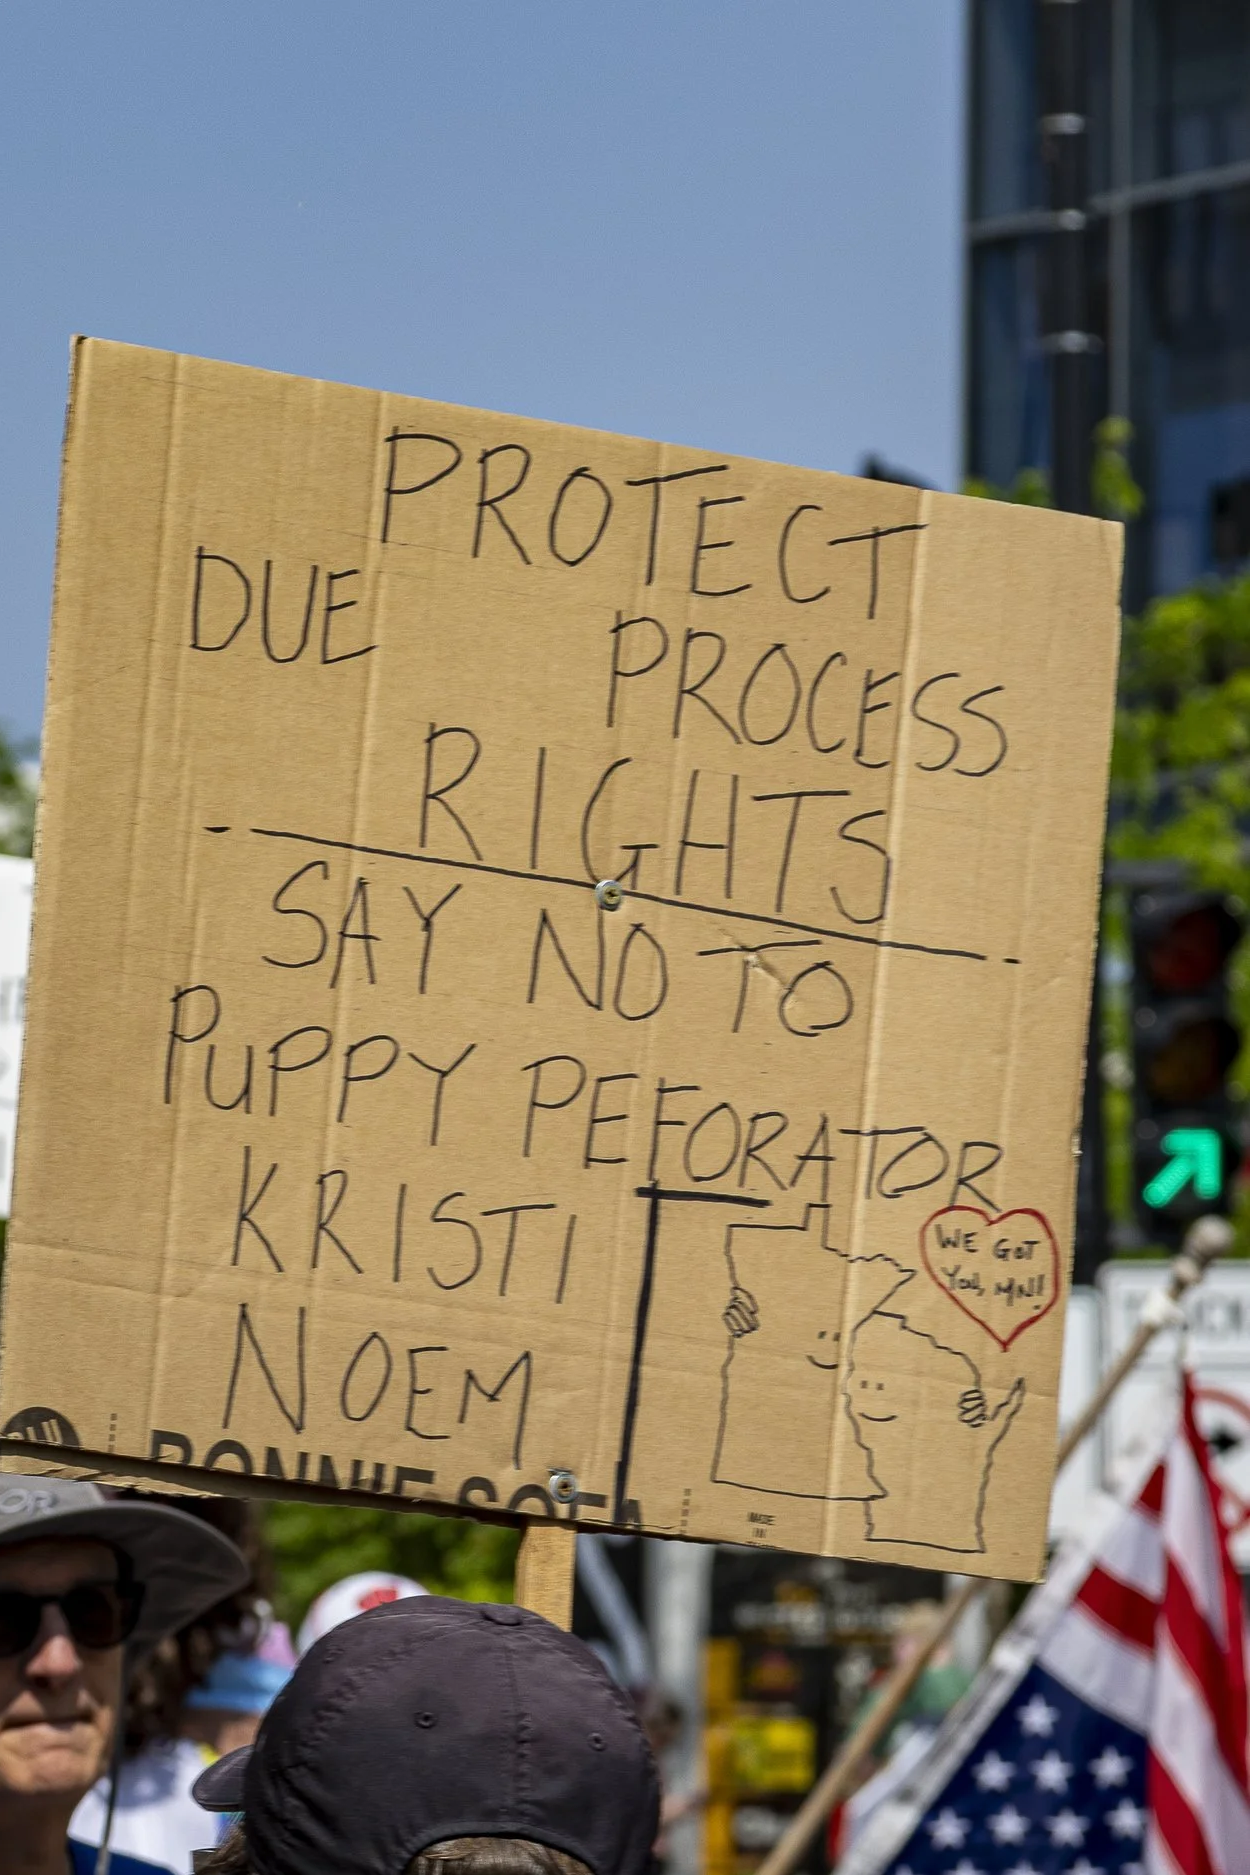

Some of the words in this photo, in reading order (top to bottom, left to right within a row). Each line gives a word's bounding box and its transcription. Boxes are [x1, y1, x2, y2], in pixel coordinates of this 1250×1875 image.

[383, 426, 927, 620] PROTECT
[189, 546, 377, 665] DUE
[609, 609, 1008, 777] PROCESS
[421, 721, 892, 924] RIGHTS
[261, 860, 463, 995] SAY
[527, 908, 670, 1021] NO
[697, 938, 854, 1038] TO
[521, 1054, 1003, 1212] PEFORATOR
[232, 1145, 578, 1304] KRISTI
[935, 1224, 978, 1253] WE
[223, 1302, 533, 1470] NOEM
